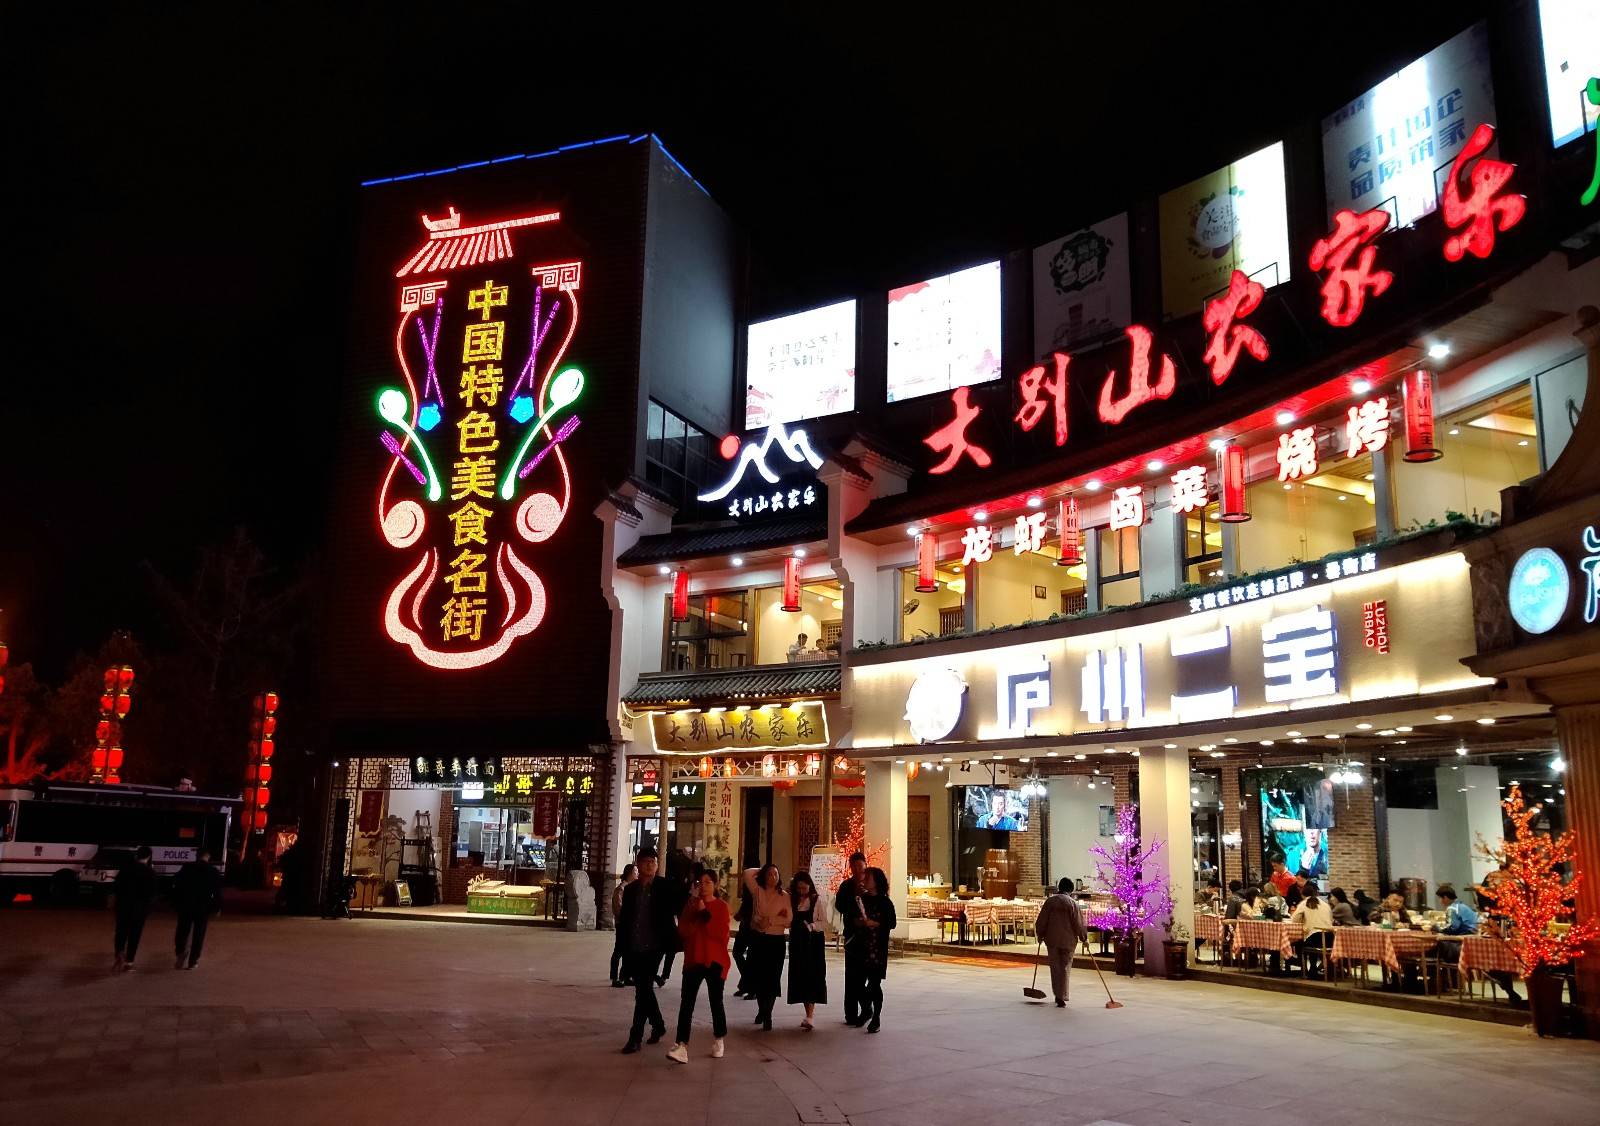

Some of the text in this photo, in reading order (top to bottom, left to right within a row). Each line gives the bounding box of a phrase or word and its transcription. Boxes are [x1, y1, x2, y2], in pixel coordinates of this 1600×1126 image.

[925, 123, 1526, 475] 大别山农家乐
[441, 279, 509, 641] 中国特色美食名街
[961, 511, 1048, 566] 龙虾
[1109, 465, 1210, 532] 卤菜
[1277, 396, 1390, 482] 烧烤
[728, 485, 817, 518] 大别山农家乐
[1363, 602, 1375, 649] ERBAO
[1376, 599, 1390, 656] LUZHOU
[997, 604, 1339, 733] 庐州二宝
[667, 711, 815, 745] 大别山农家乐
[163, 850, 190, 859] POLICE
